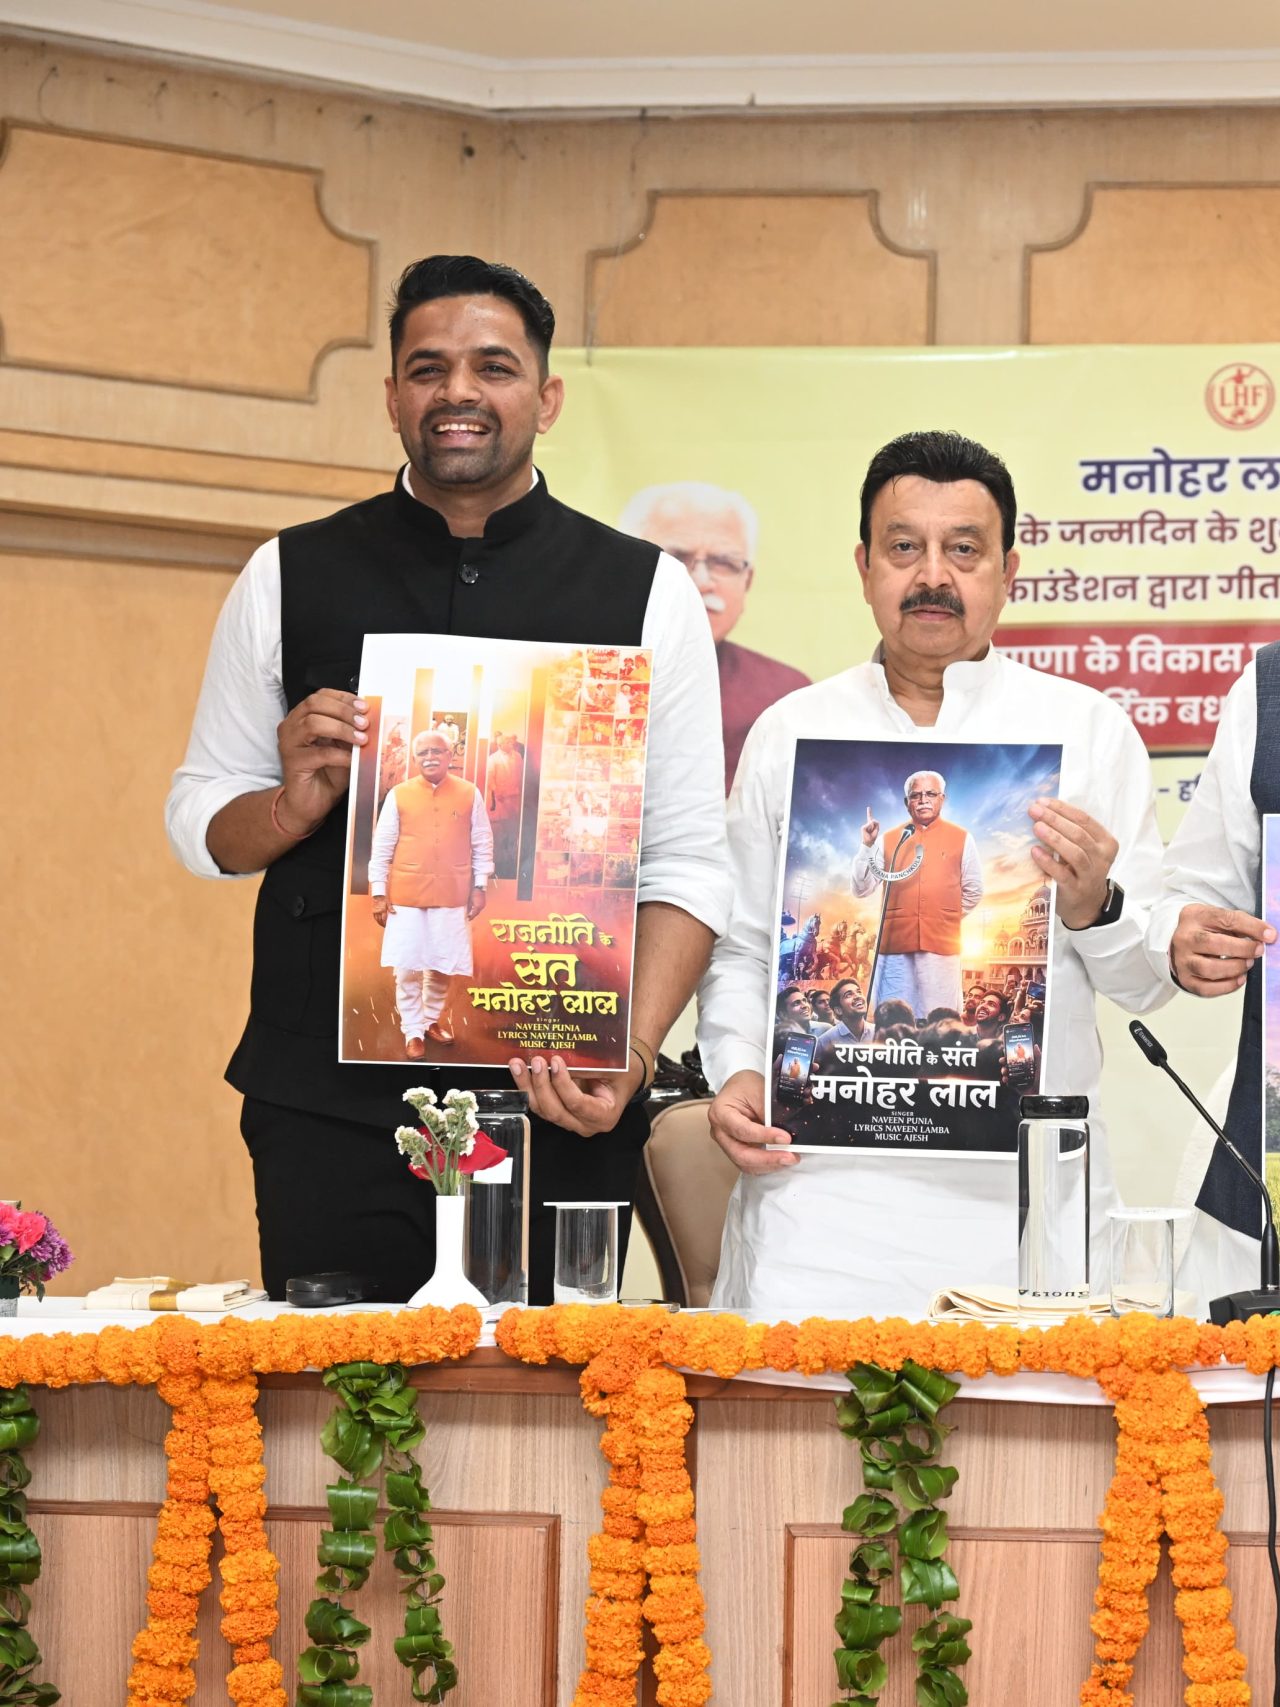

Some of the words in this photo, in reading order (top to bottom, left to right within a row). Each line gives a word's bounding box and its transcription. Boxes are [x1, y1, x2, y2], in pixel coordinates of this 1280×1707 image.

[1219, 384, 1264, 407] LHF
[1080, 448, 1229, 497] मनोहर
[1018, 514, 1050, 546] के
[1058, 510, 1198, 545] जन्मदिन
[1205, 511, 1240, 544] के
[1148, 575, 1209, 608] द्वारा
[1217, 566, 1280, 600] गीत
[1083, 635, 1122, 674] के
[1127, 634, 1244, 674] विकास
[489, 912, 595, 945] राजनीति
[510, 946, 579, 987] संत
[467, 981, 557, 1015] मनोहर
[560, 990, 619, 1015] लाल
[516, 1023, 550, 1031] NAVEEN
[552, 1024, 580, 1032] PUNIA
[567, 1033, 597, 1041] LAMBA
[520, 1040, 547, 1048] MUSIC
[549, 1041, 575, 1049] AJESH
[834, 1038, 924, 1065] राजनीति
[926, 1051, 938, 1065] के
[941, 1040, 979, 1067] संत
[810, 1066, 919, 1109] मनोहर
[928, 1079, 1000, 1109] लाल
[854, 1124, 883, 1132] LYRICS
[885, 1125, 918, 1133] NAVEEN
[920, 1126, 950, 1134] LAMBA
[872, 1116, 904, 1124] NAVEEN
[906, 1117, 933, 1125] PUNIA
[875, 1133, 902, 1141] MUSIC
[903, 1134, 928, 1142] AJESH
